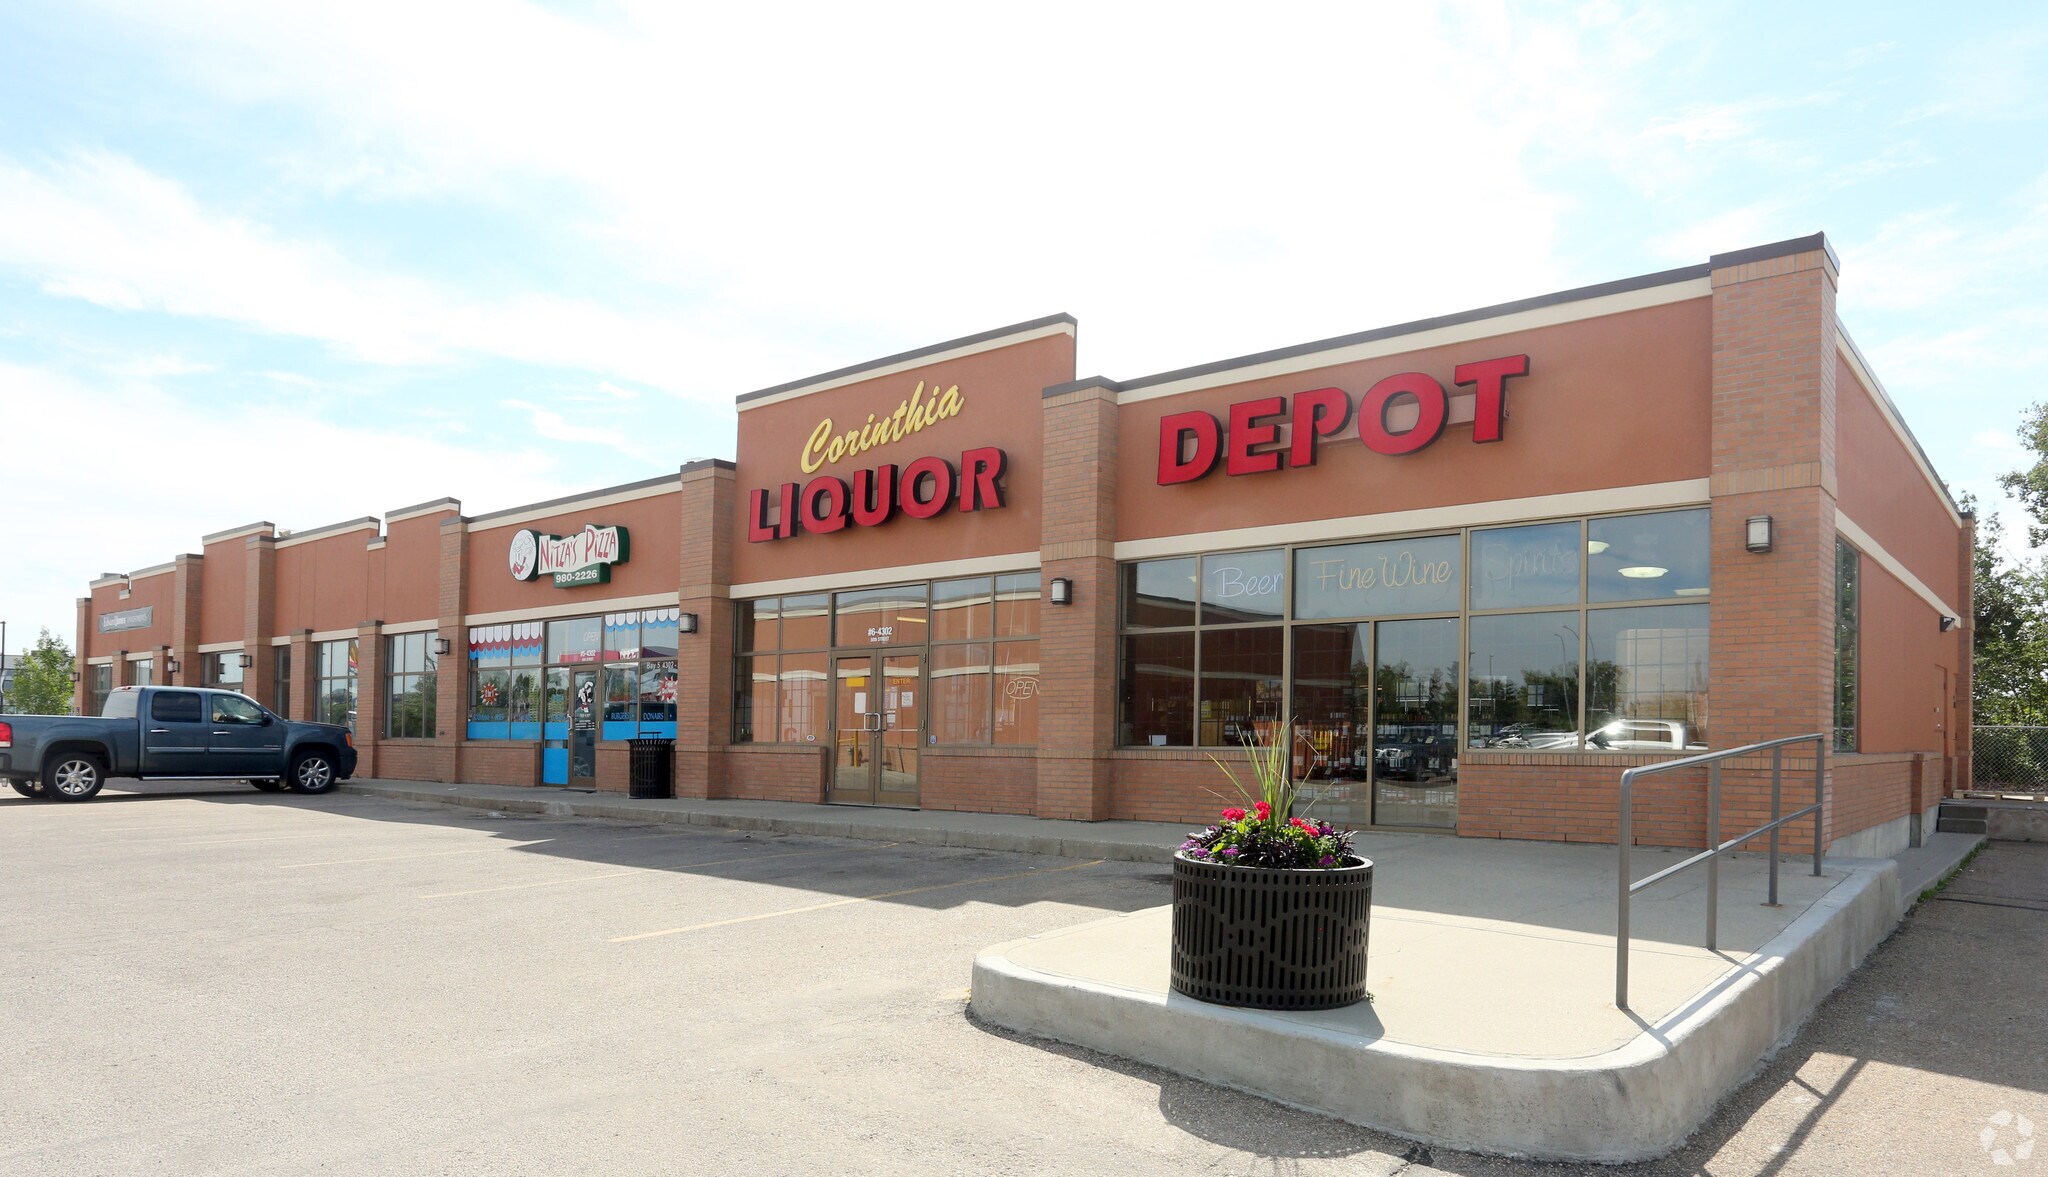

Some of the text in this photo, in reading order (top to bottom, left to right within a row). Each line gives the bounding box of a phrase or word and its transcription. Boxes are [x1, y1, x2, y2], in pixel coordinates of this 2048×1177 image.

[801, 380, 965, 474] Corinthia
[1157, 354, 1530, 486] DEPOT
[748, 417, 1007, 543] LIQUOR
[555, 569, 598, 583] 980-2226
[1310, 551, 1452, 591] Fine Wine
[1481, 543, 1577, 592] Spirits
[1213, 567, 1283, 598] Beer
[867, 626, 893, 637] #6-4302
[646, 661, 656, 671] Bay
[657, 661, 661, 669] 5
[1006, 680, 1040, 695] OPEN
[610, 712, 630, 720] BURGERS
[642, 712, 664, 720] DONAIRS
